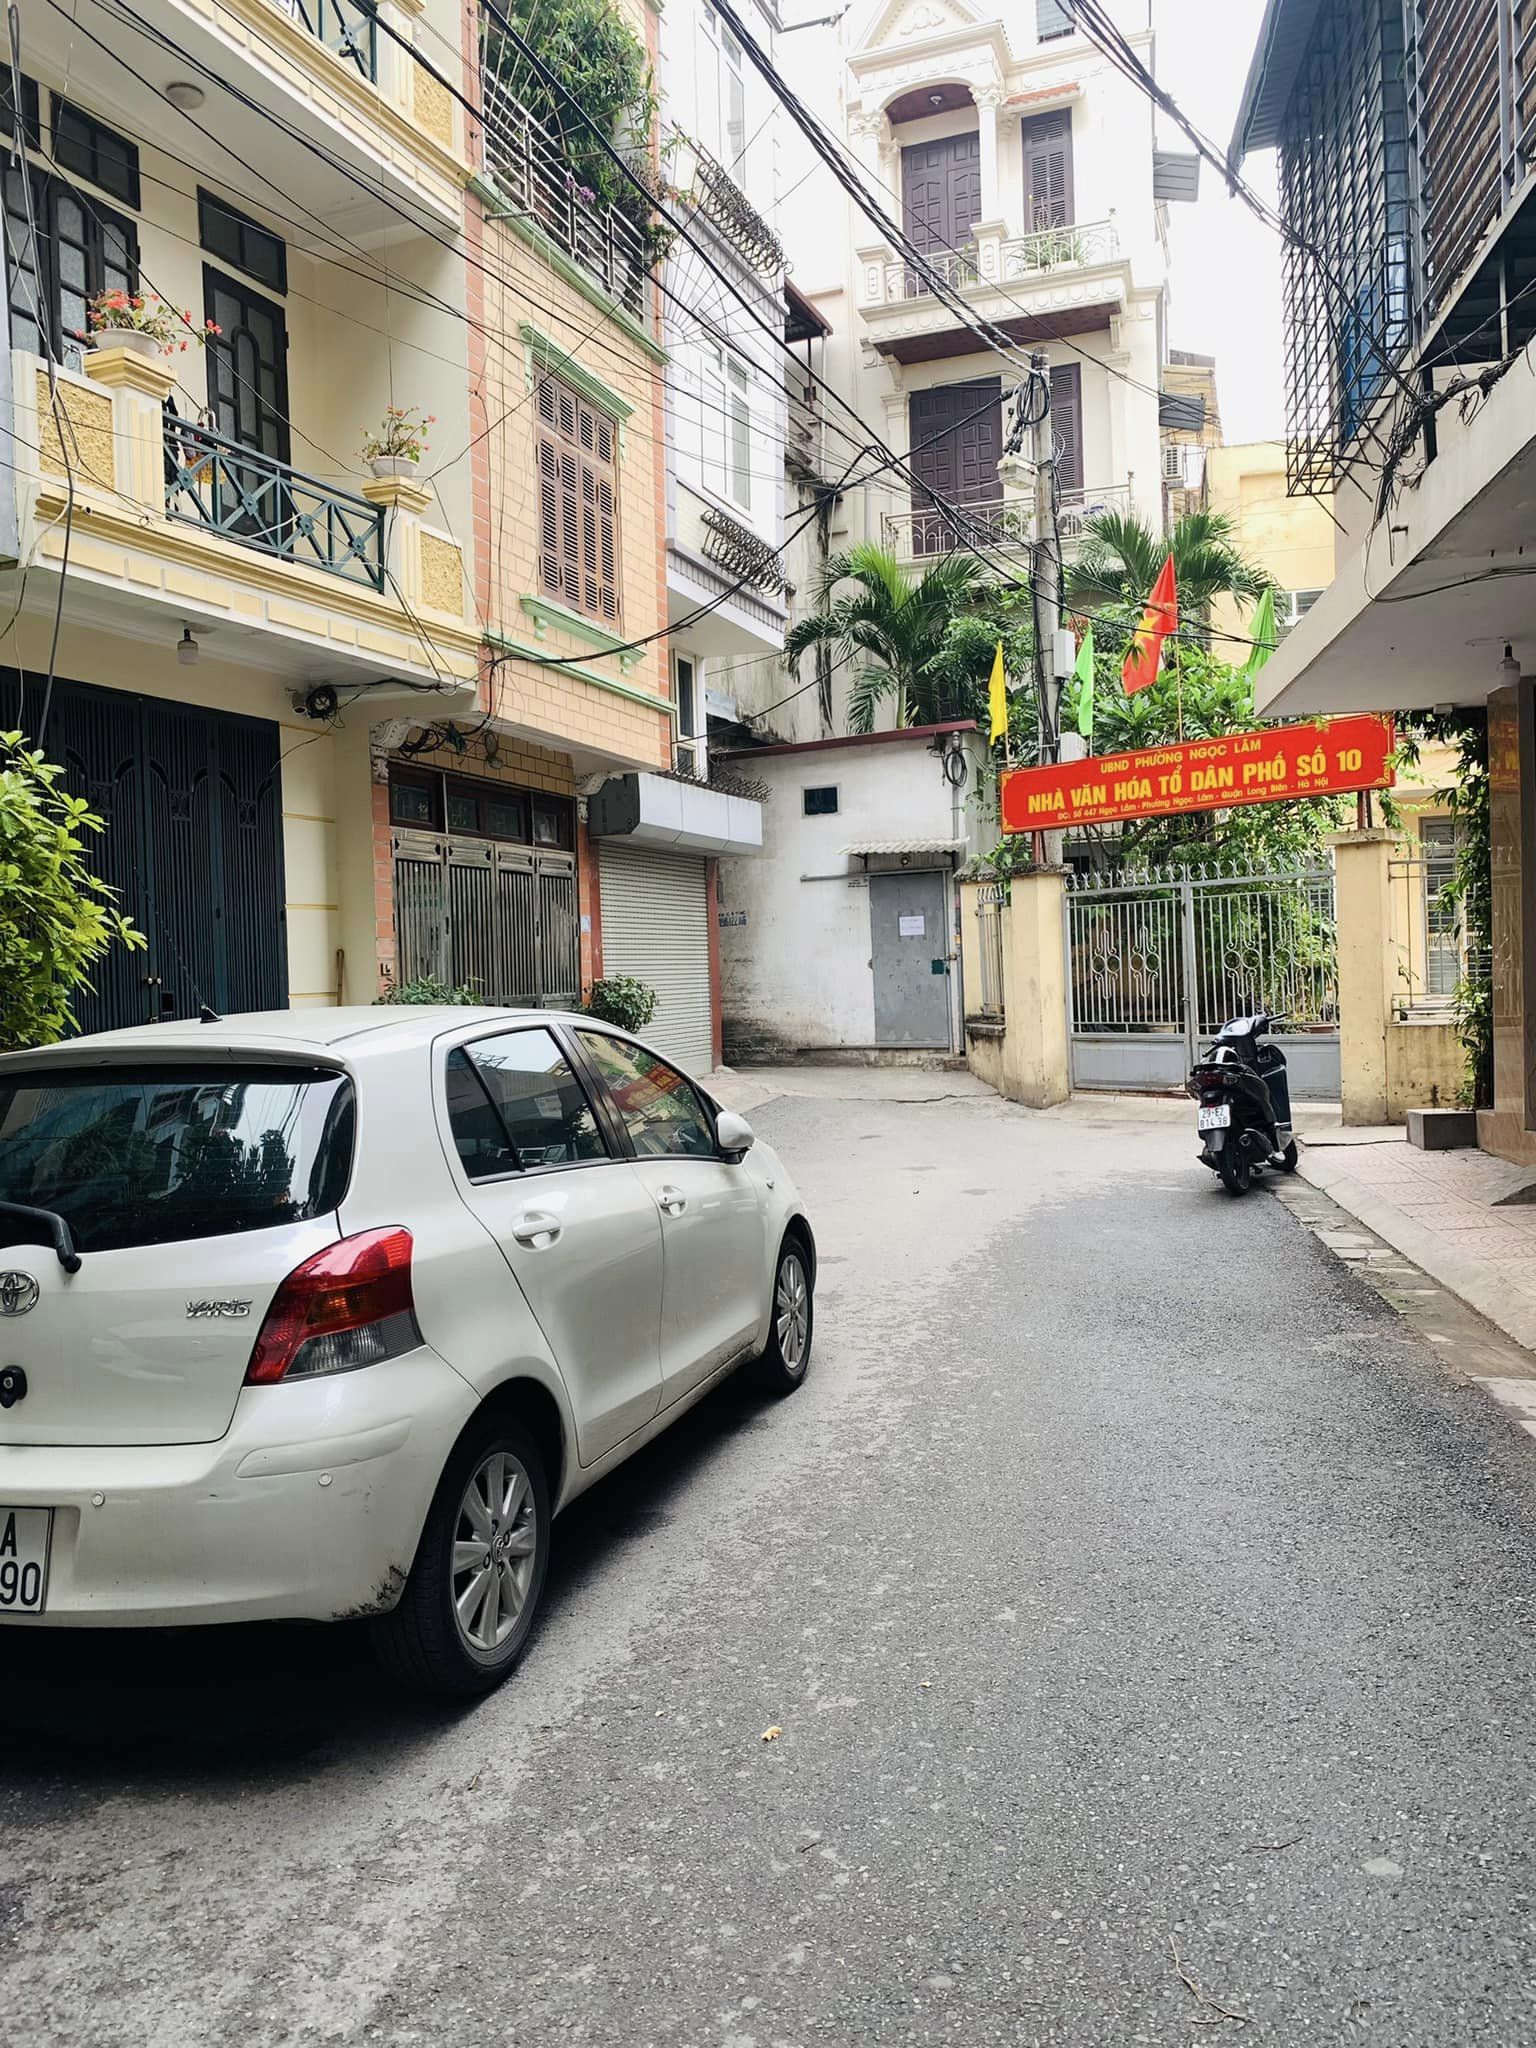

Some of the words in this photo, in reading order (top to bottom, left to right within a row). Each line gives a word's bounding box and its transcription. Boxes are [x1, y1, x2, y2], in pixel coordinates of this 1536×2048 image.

[1101, 759, 1129, 774] UBND
[1135, 750, 1183, 769] PHƯỜNG
[1189, 744, 1227, 760] NGỌC
[1234, 738, 1261, 753] LÂM
[1028, 787, 1065, 814] NHÀ
[1070, 783, 1106, 807] VĂN
[1114, 776, 1152, 802] HÓA
[1158, 765, 1182, 796] TỔ
[1191, 764, 1233, 791] DÂN
[1243, 751, 1287, 784] PHỐ
[1296, 744, 1327, 776] SỐ
[1336, 749, 1362, 772] 10
[1084, 808, 1097, 816] 447
[1099, 806, 1118, 816] Ngọc
[1120, 803, 1136, 812] Lâm
[1173, 795, 1193, 806] Ngọc
[1247, 786, 1267, 796] Long
[1271, 783, 1288, 793] Biên
[1298, 778, 1310, 789] Hà
[1314, 777, 1329, 787] Nội
[0, 1561, 41, 1606] 90
